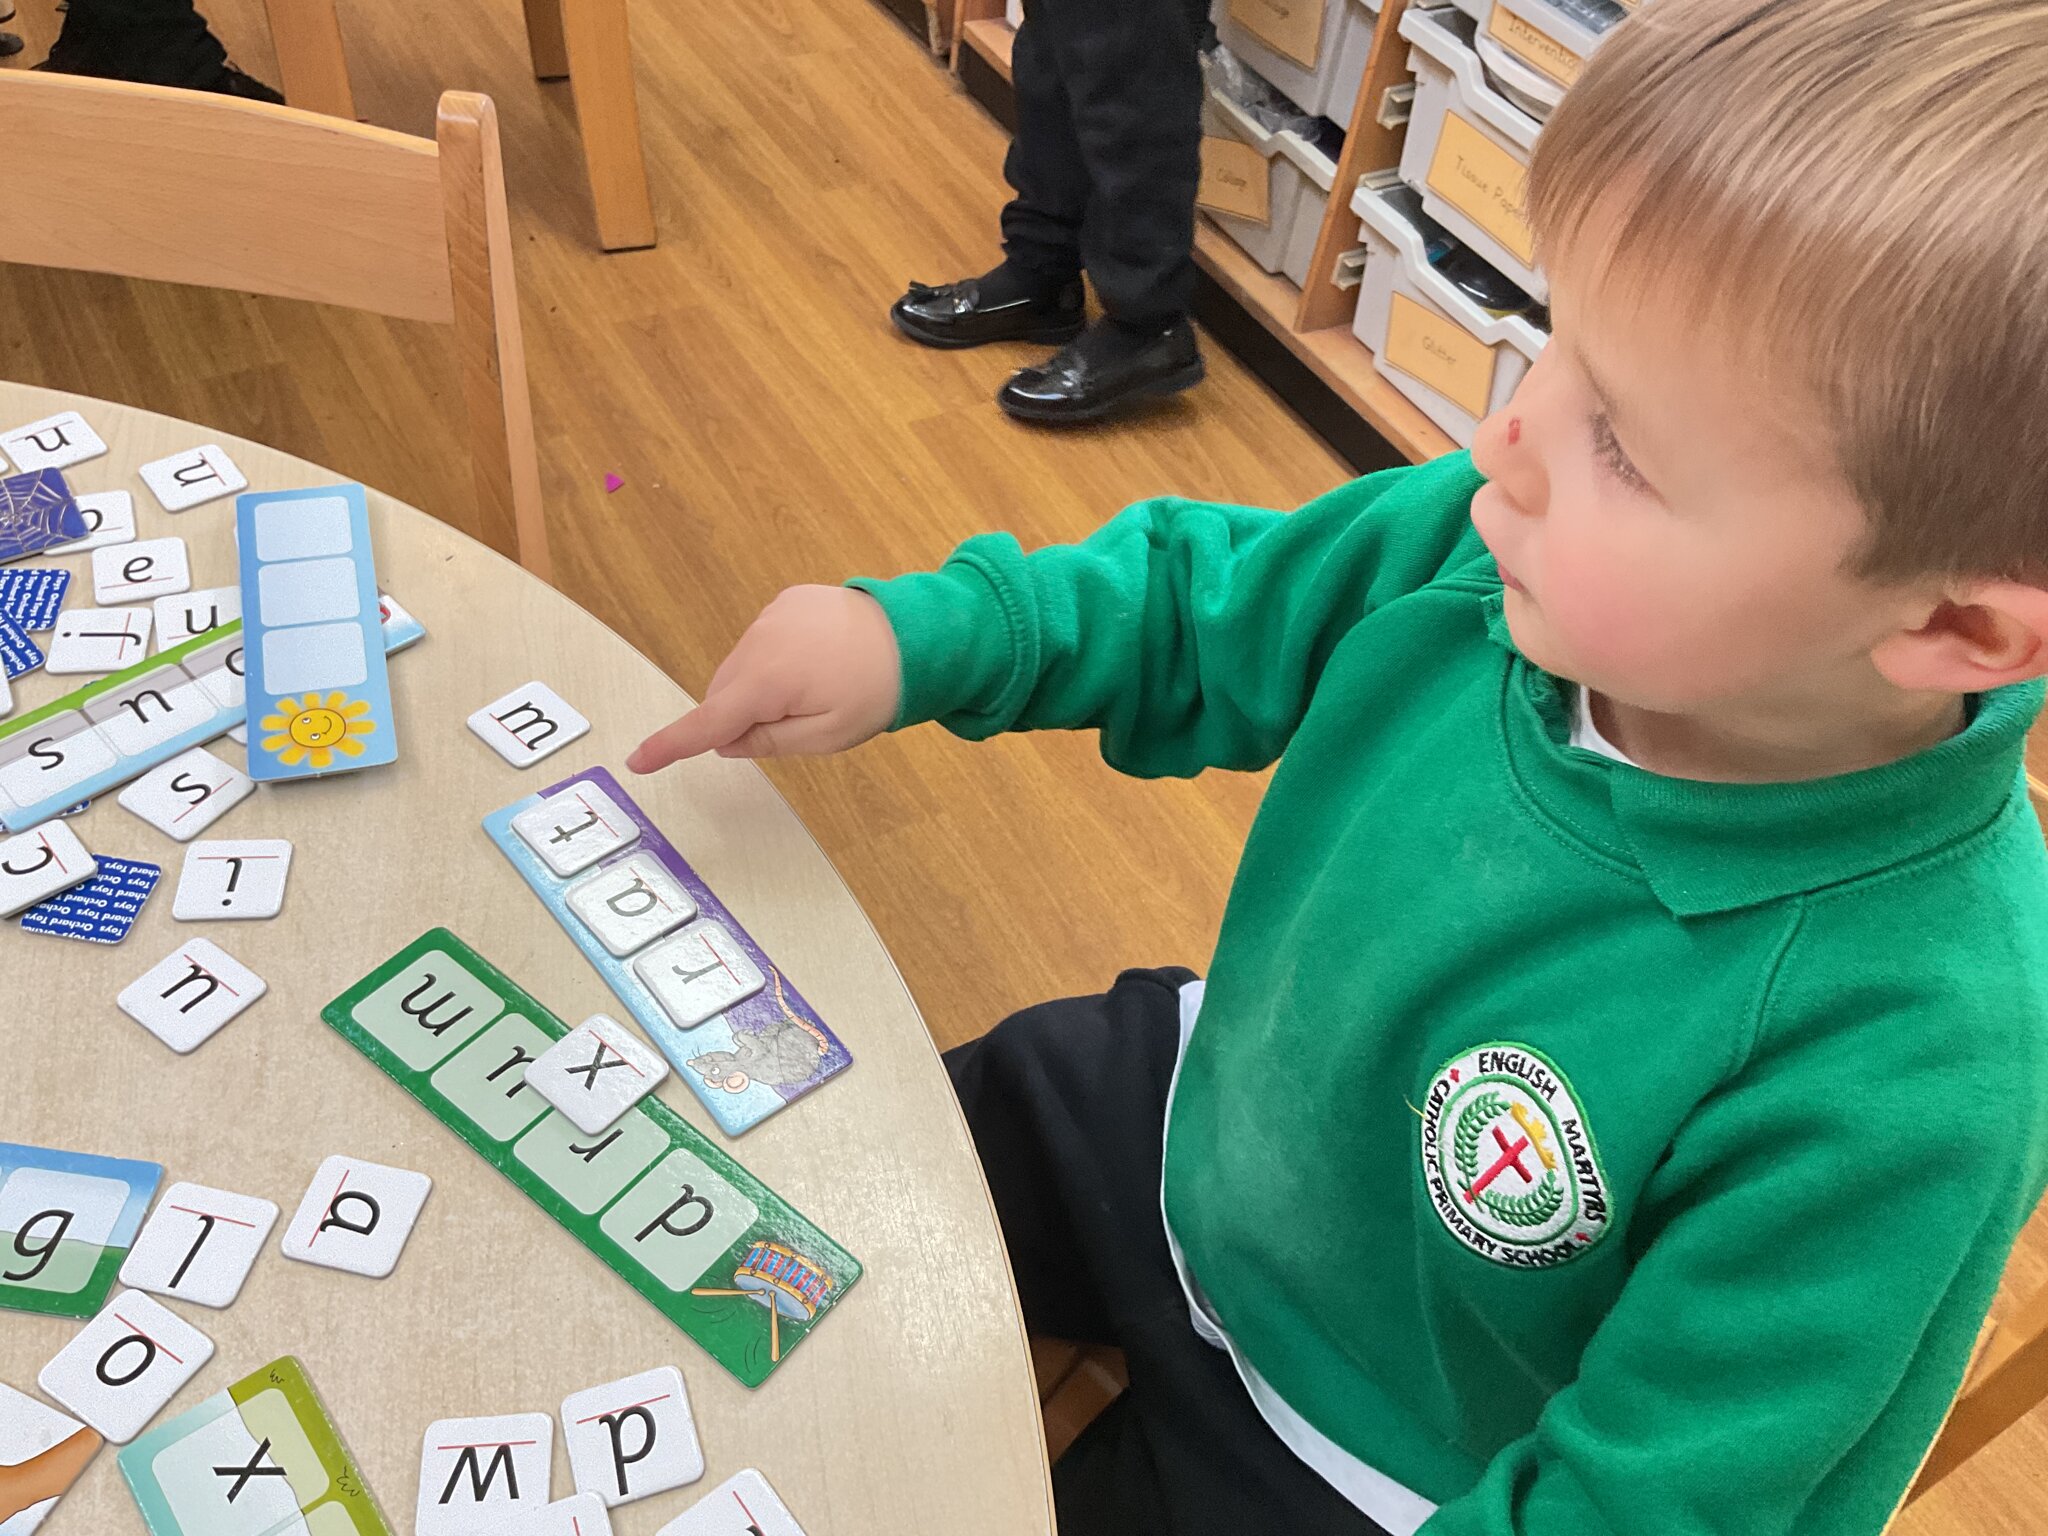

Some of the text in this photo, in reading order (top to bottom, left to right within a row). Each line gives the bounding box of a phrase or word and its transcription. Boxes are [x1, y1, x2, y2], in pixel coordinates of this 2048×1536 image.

[123, 557, 153, 583] e
[185, 605, 218, 635] u
[28, 690, 173, 771] s n
[497, 701, 558, 751] m
[170, 773, 211, 805] s
[549, 810, 599, 844] t
[103, 860, 128, 874] Toys
[126, 876, 151, 890] Toys
[222, 857, 242, 906] i
[63, 893, 108, 908] Orchard
[89, 883, 115, 897] Toys
[113, 900, 137, 913] Toys
[606, 877, 658, 917] a
[49, 916, 94, 932] Orchard
[75, 907, 100, 920] Toys
[100, 924, 124, 937] Toys
[565, 1042, 628, 1091] x
[1423, 1078, 1451, 1175] CATHOLIC
[1477, 1050, 1607, 1224] ENGLISH MARTYRS
[1429, 1176, 1498, 1256] PRIMARY
[2, 1209, 75, 1282] g
[95, 1334, 156, 1387] o
[212, 1437, 287, 1504] x
